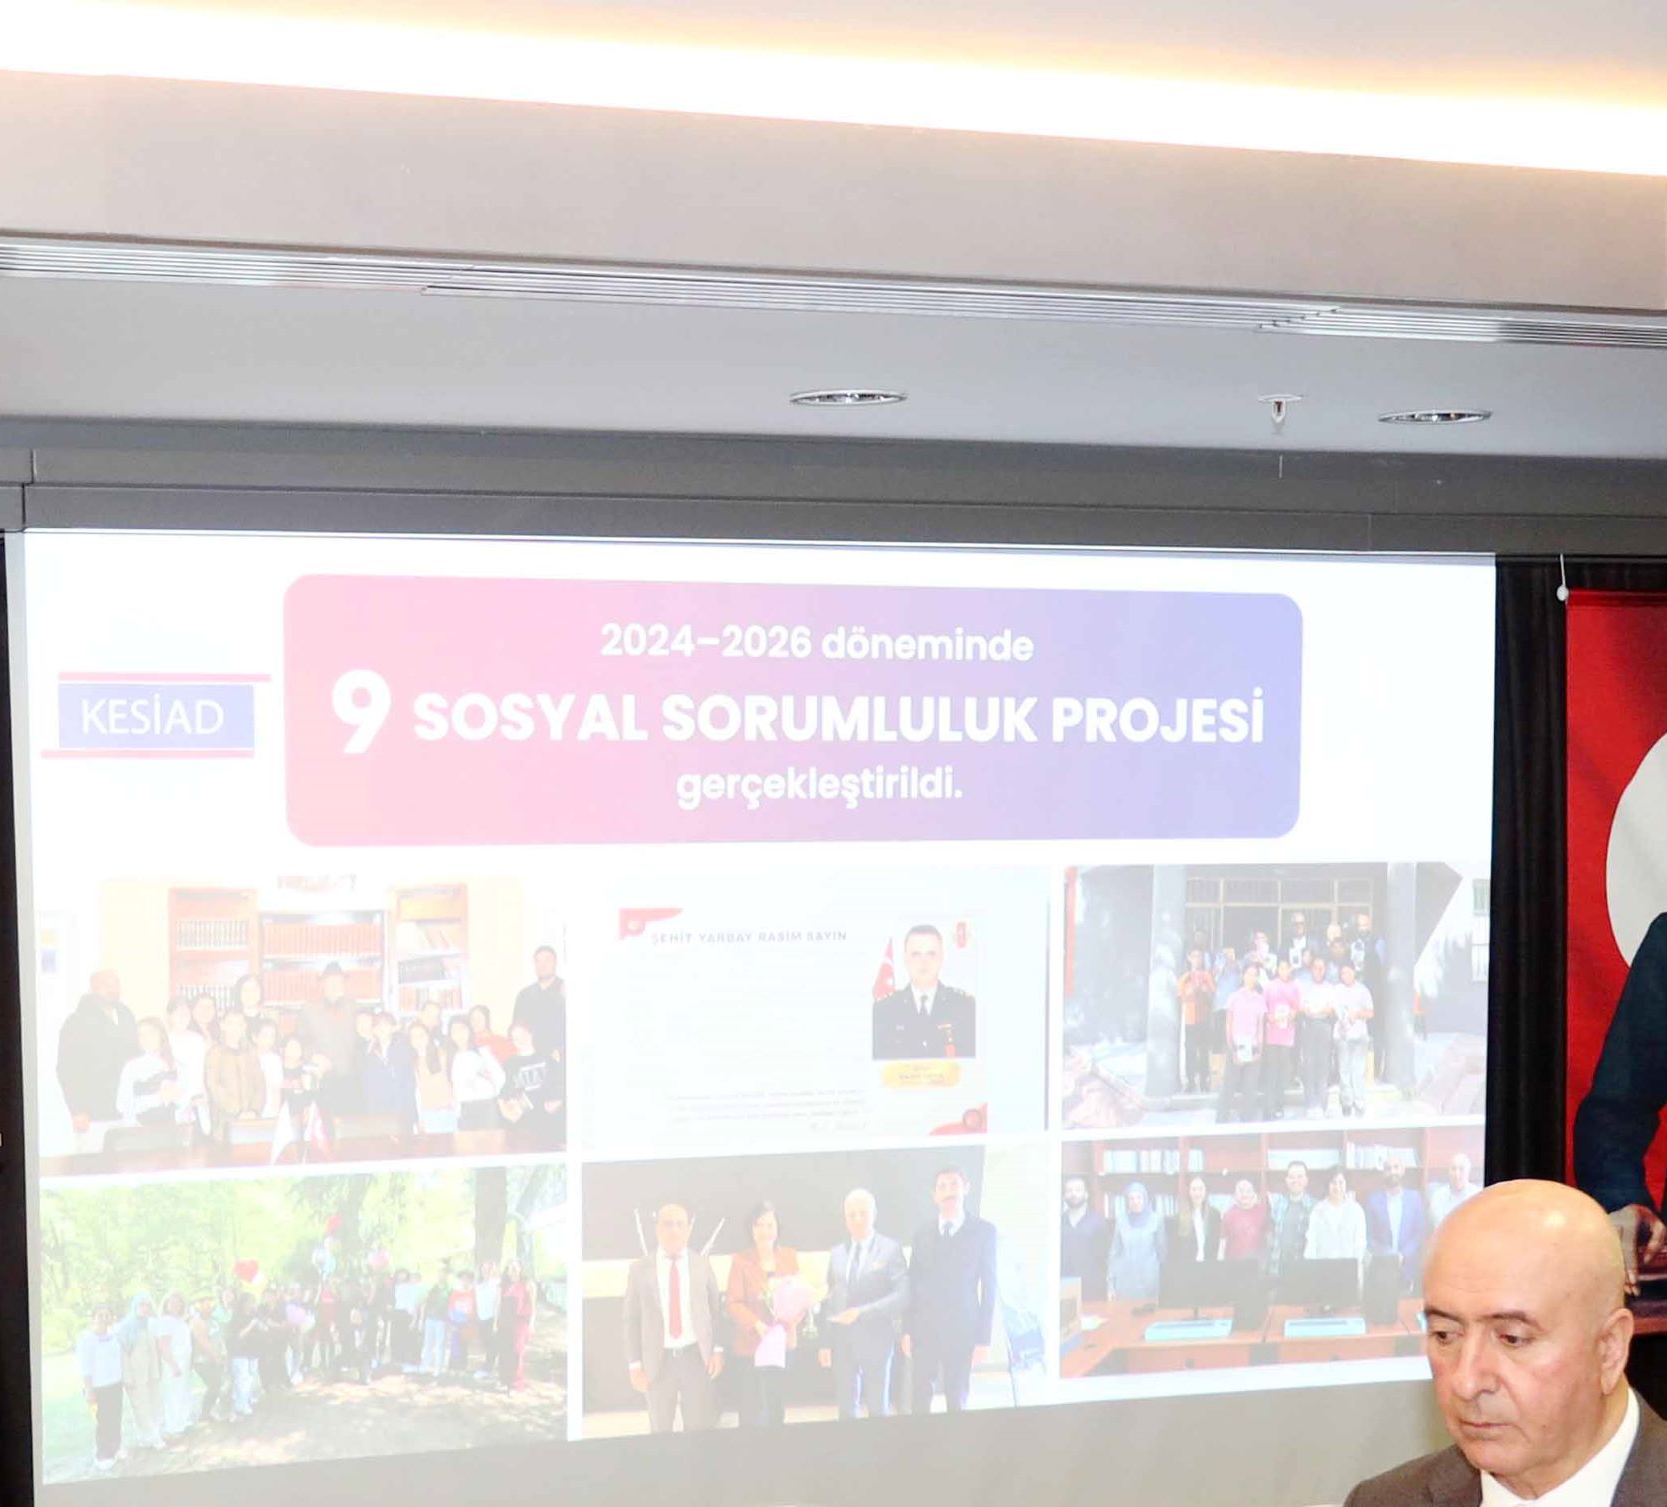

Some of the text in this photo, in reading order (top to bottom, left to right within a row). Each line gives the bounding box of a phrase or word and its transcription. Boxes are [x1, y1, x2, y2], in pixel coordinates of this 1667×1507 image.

[821, 624, 1035, 662] döneminde
[81, 691, 225, 737] KESİAD
[332, 668, 1265, 754] 9 SOSYAL SORUMLULUK PROJESİ
[676, 765, 964, 810] gerçekleştirildi.
